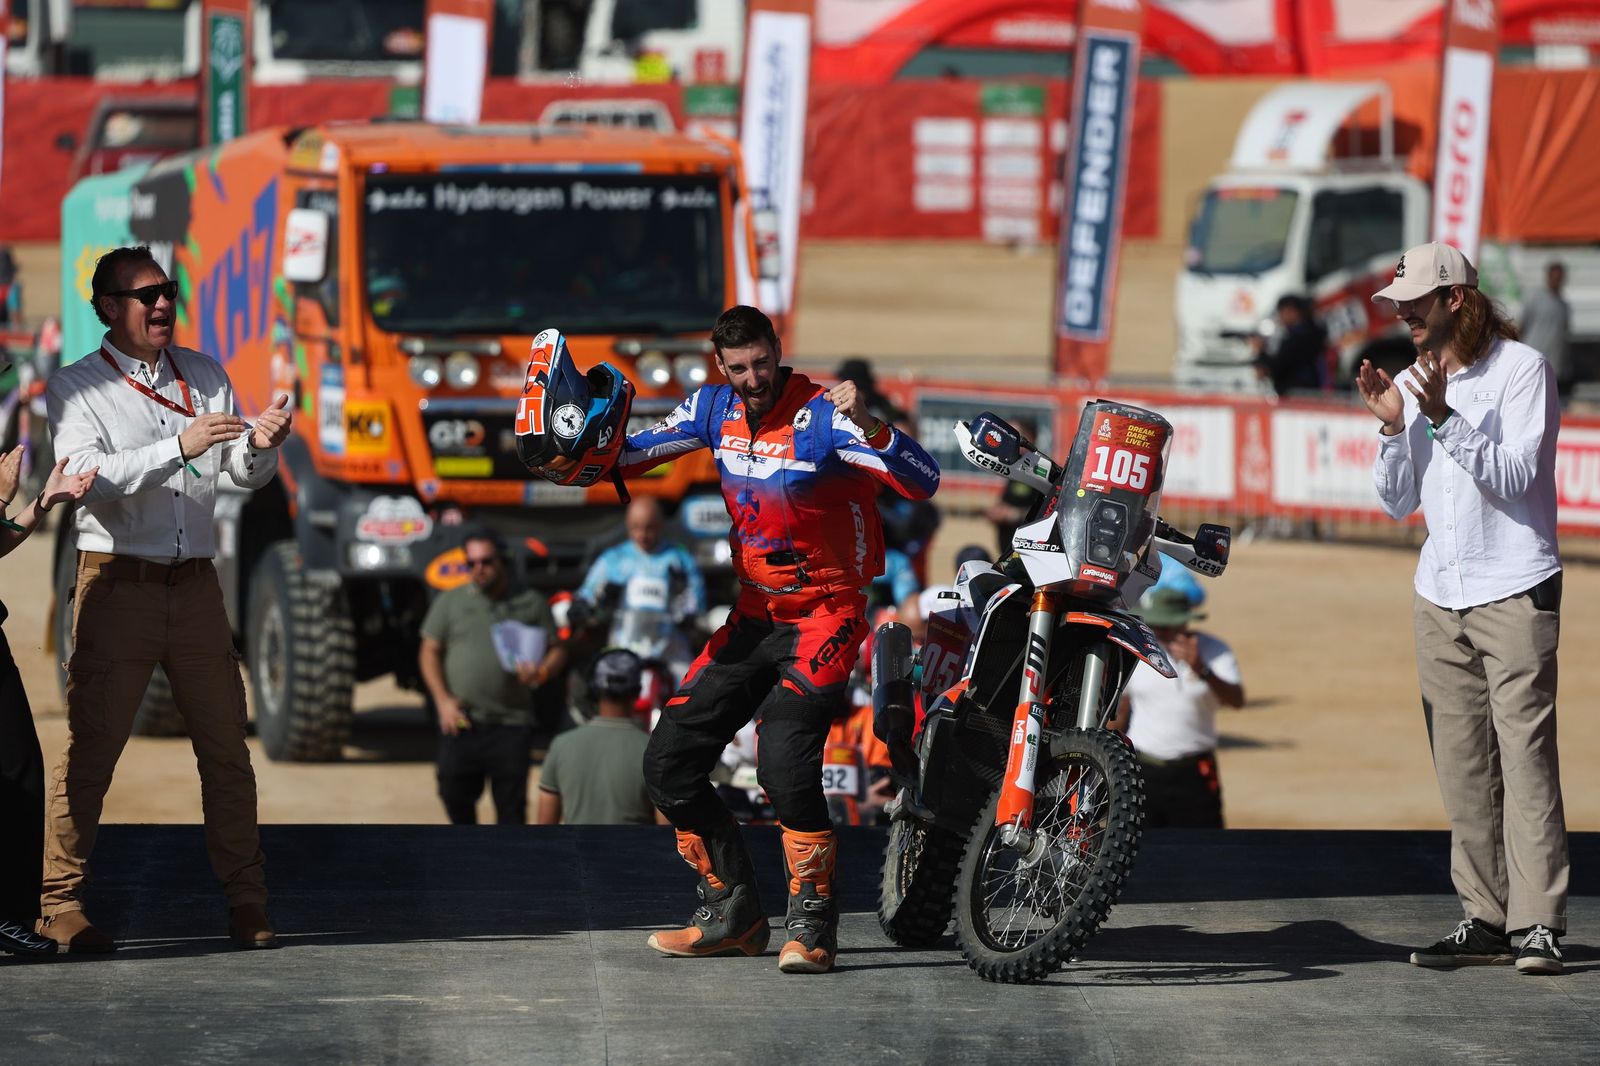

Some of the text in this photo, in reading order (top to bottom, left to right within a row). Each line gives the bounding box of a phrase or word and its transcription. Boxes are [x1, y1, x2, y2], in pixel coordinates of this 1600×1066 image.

[434, 181, 564, 216] Hydrogen
[571, 181, 653, 211] Power
[1064, 45, 1121, 326] DEFENDER
[1125, 437, 1151, 449] LIVE IT.
[1126, 431, 1149, 442] DARE.
[1127, 424, 1156, 437] DREAM.
[900, 449, 940, 482] KENNY
[967, 449, 1011, 476] ACERBIS
[1091, 446, 1151, 490] 105
[848, 500, 867, 578] KENNY
[1083, 568, 1115, 581] ORIGINAL
[1014, 720, 1025, 745] MB
